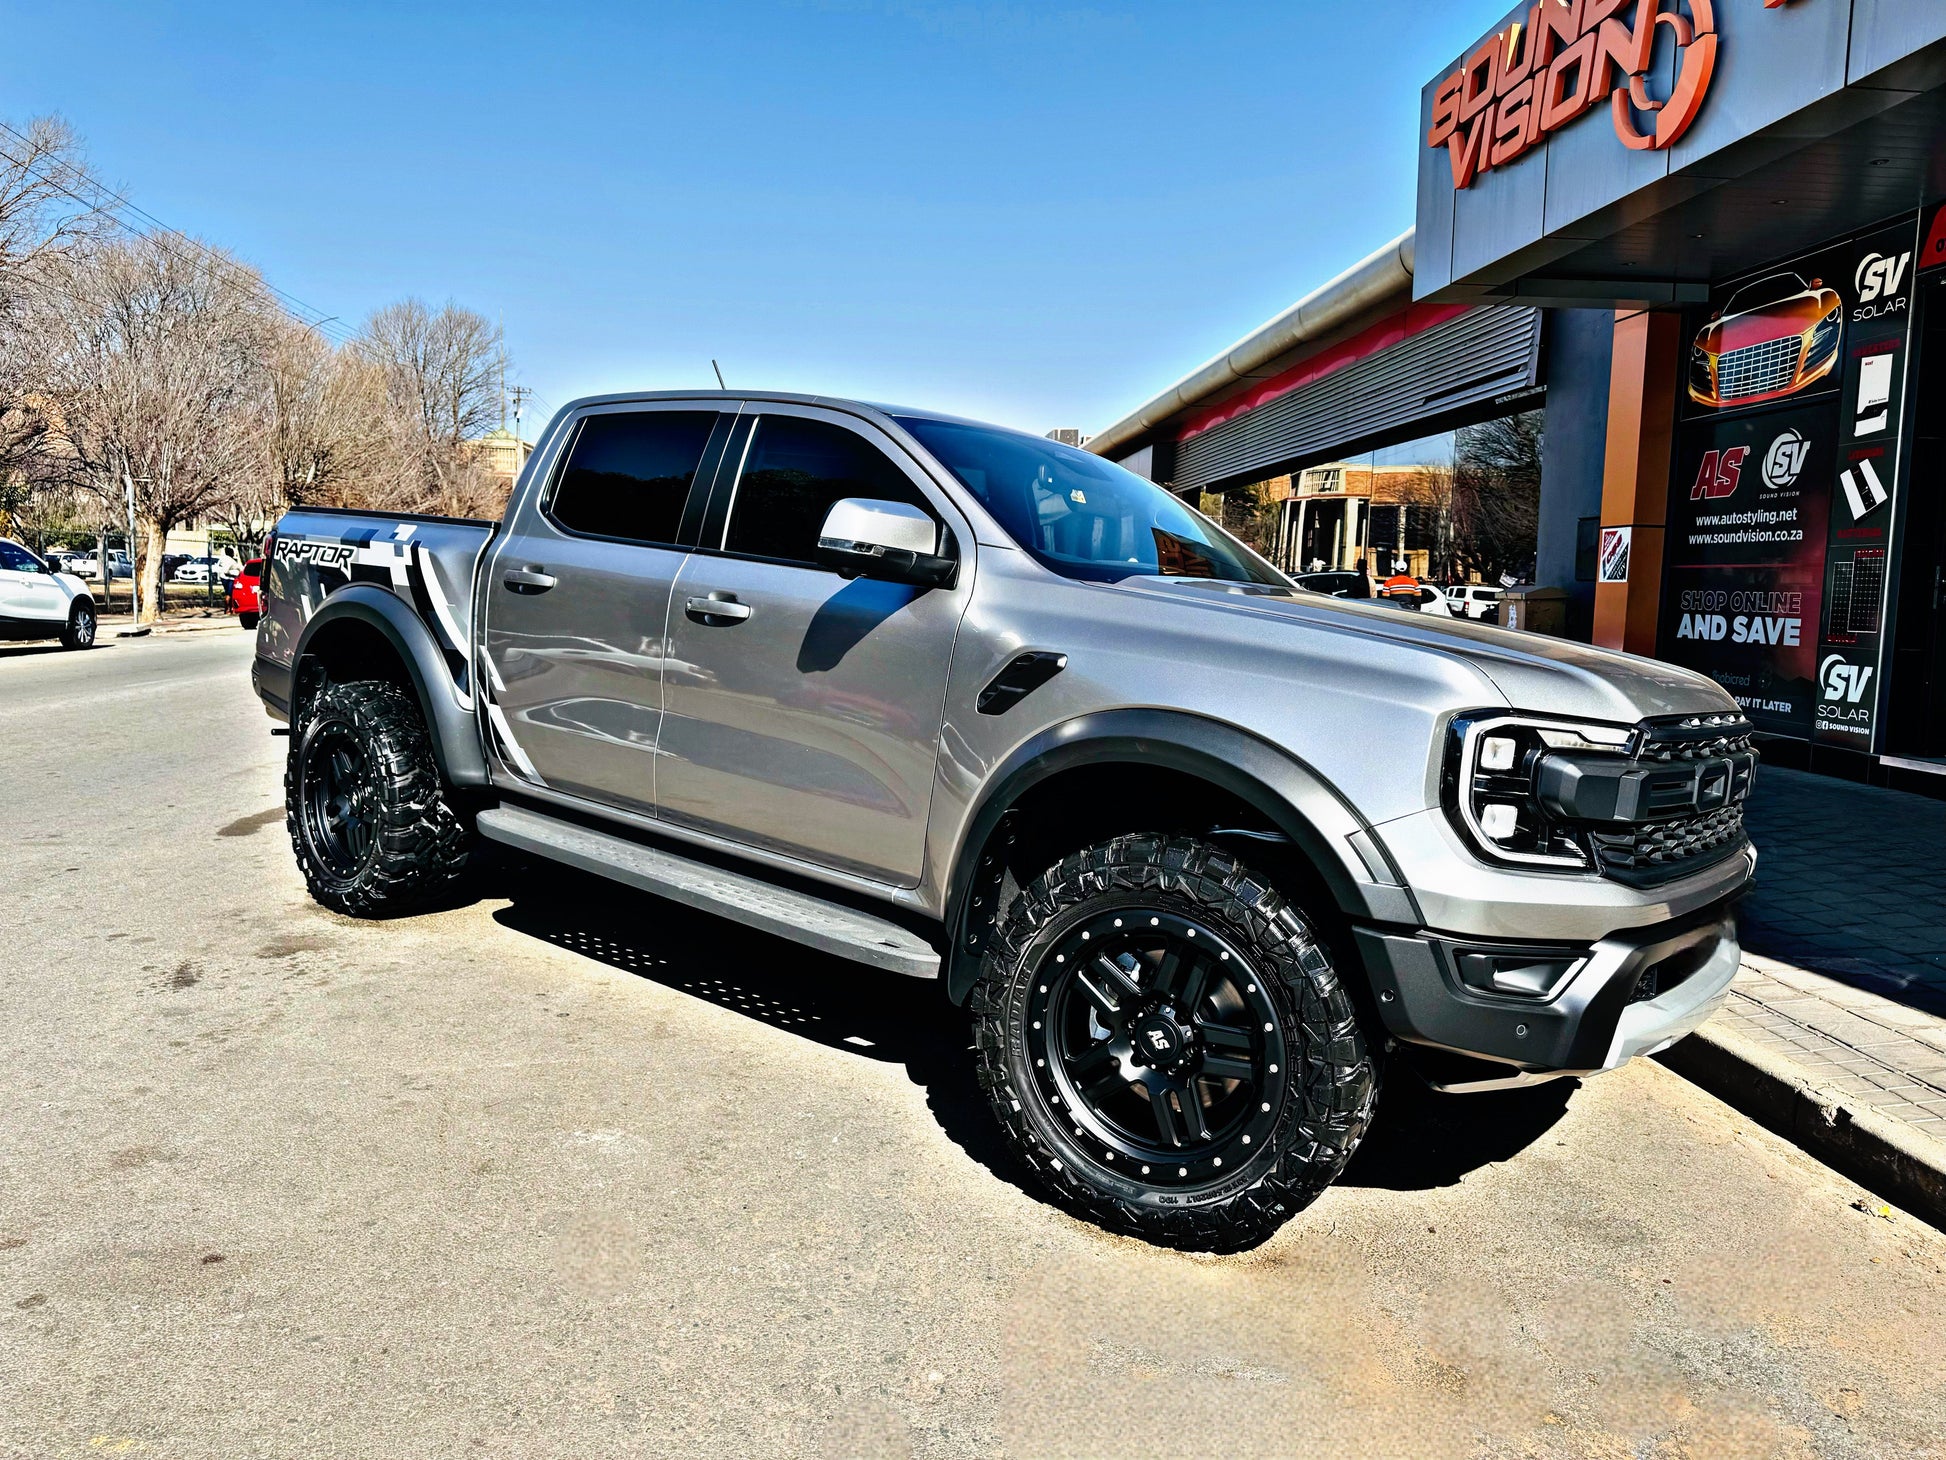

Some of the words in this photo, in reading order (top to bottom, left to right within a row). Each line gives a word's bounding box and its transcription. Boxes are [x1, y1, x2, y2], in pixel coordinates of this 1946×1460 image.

[1448, 0, 1658, 189] VISION
[1859, 251, 1911, 303] SV
[1852, 297, 1906, 322] SOLAR
[1771, 441, 1811, 477] SV
[1780, 490, 1800, 498] VISION
[1695, 507, 1798, 526] www.autostyling.net
[1688, 529, 1803, 544] www.soundvision.co.za
[275, 538, 357, 580] RAPTOR
[1680, 590, 1727, 611] SHOP
[1730, 591, 1801, 614] ONLINE
[1676, 613, 1727, 640] AND
[1731, 615, 1802, 646] SAVE
[1824, 664, 1873, 703] SV
[1734, 696, 1751, 707] PAY
[1752, 698, 1762, 709] IT
[1762, 700, 1792, 713] LATER
[1817, 705, 1869, 722] SOLAR
[1828, 722, 1849, 733] SOUND
[1849, 725, 1870, 735] VISION
[1147, 1030, 1170, 1050] AS
